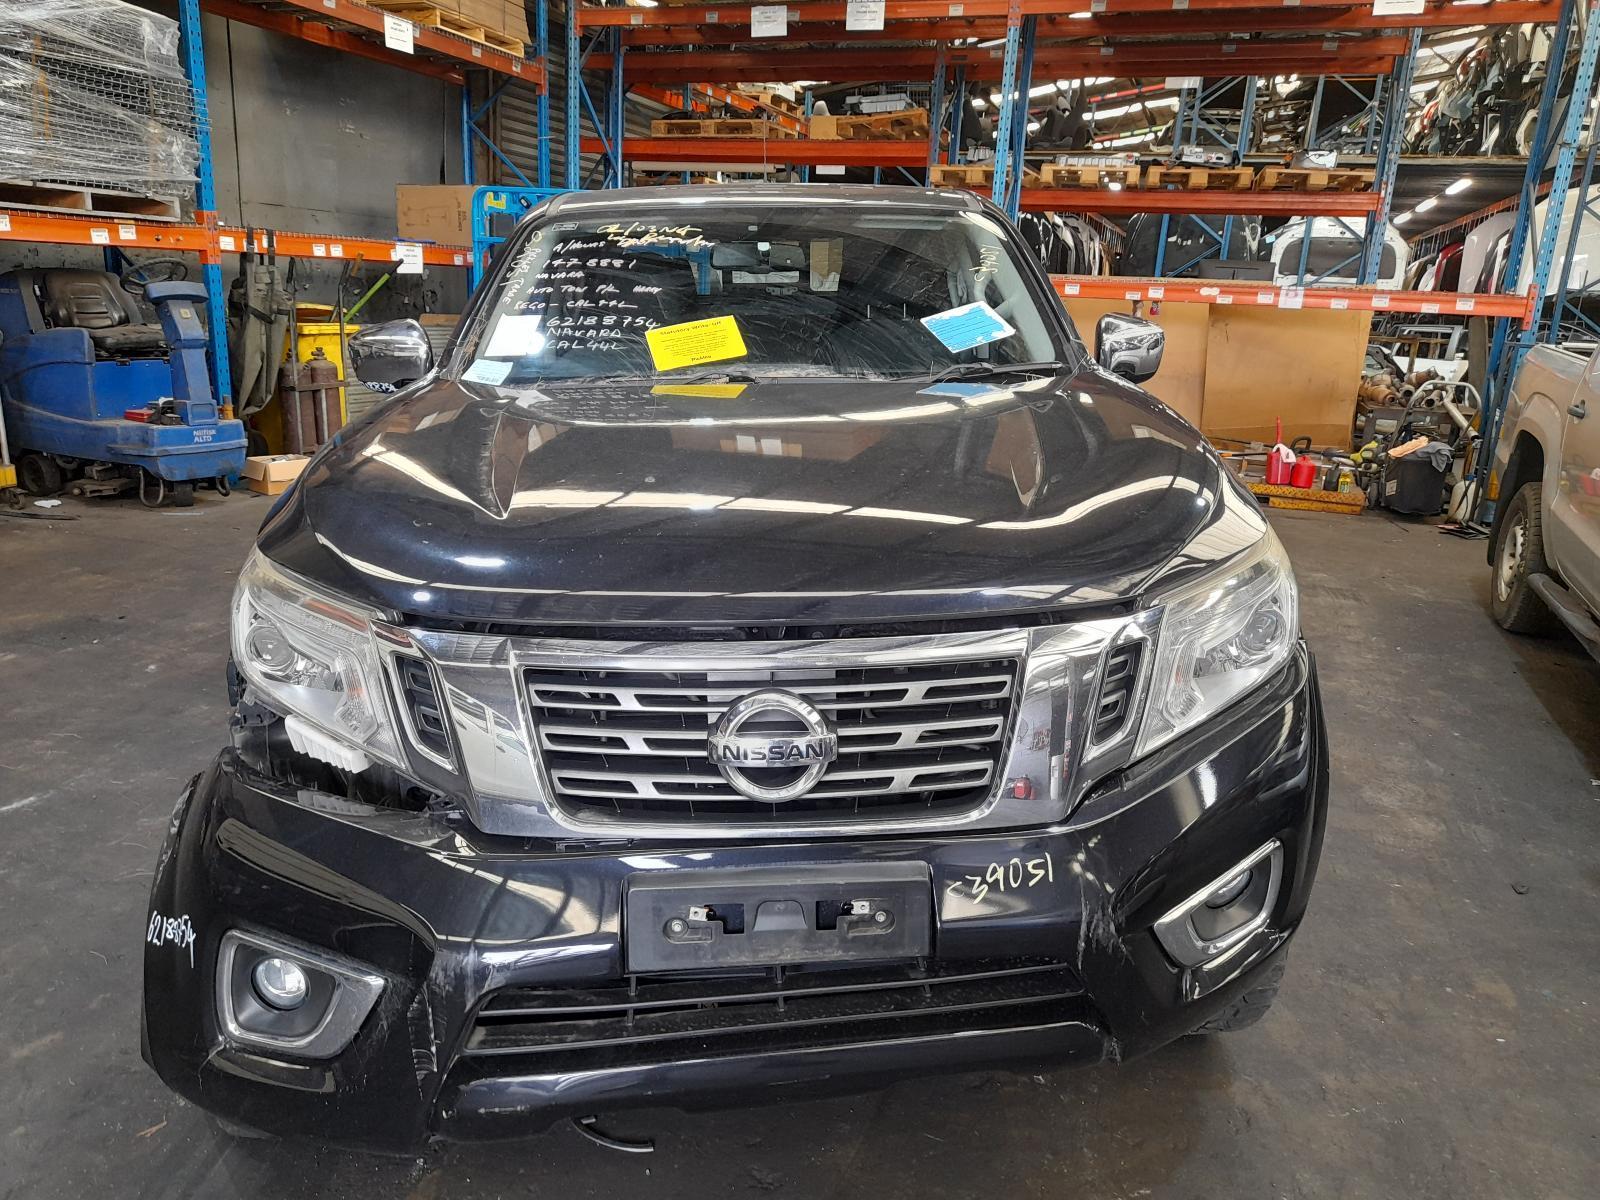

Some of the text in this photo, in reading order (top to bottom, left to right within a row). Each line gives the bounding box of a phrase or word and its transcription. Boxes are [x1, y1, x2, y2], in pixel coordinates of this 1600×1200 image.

[535, 271, 585, 279] NAVARA
[527, 286, 554, 294] AUTO
[560, 285, 588, 293] TOW
[514, 301, 546, 310] REGO
[546, 327, 622, 338] NAVARA
[722, 743, 824, 761] NISSAN
